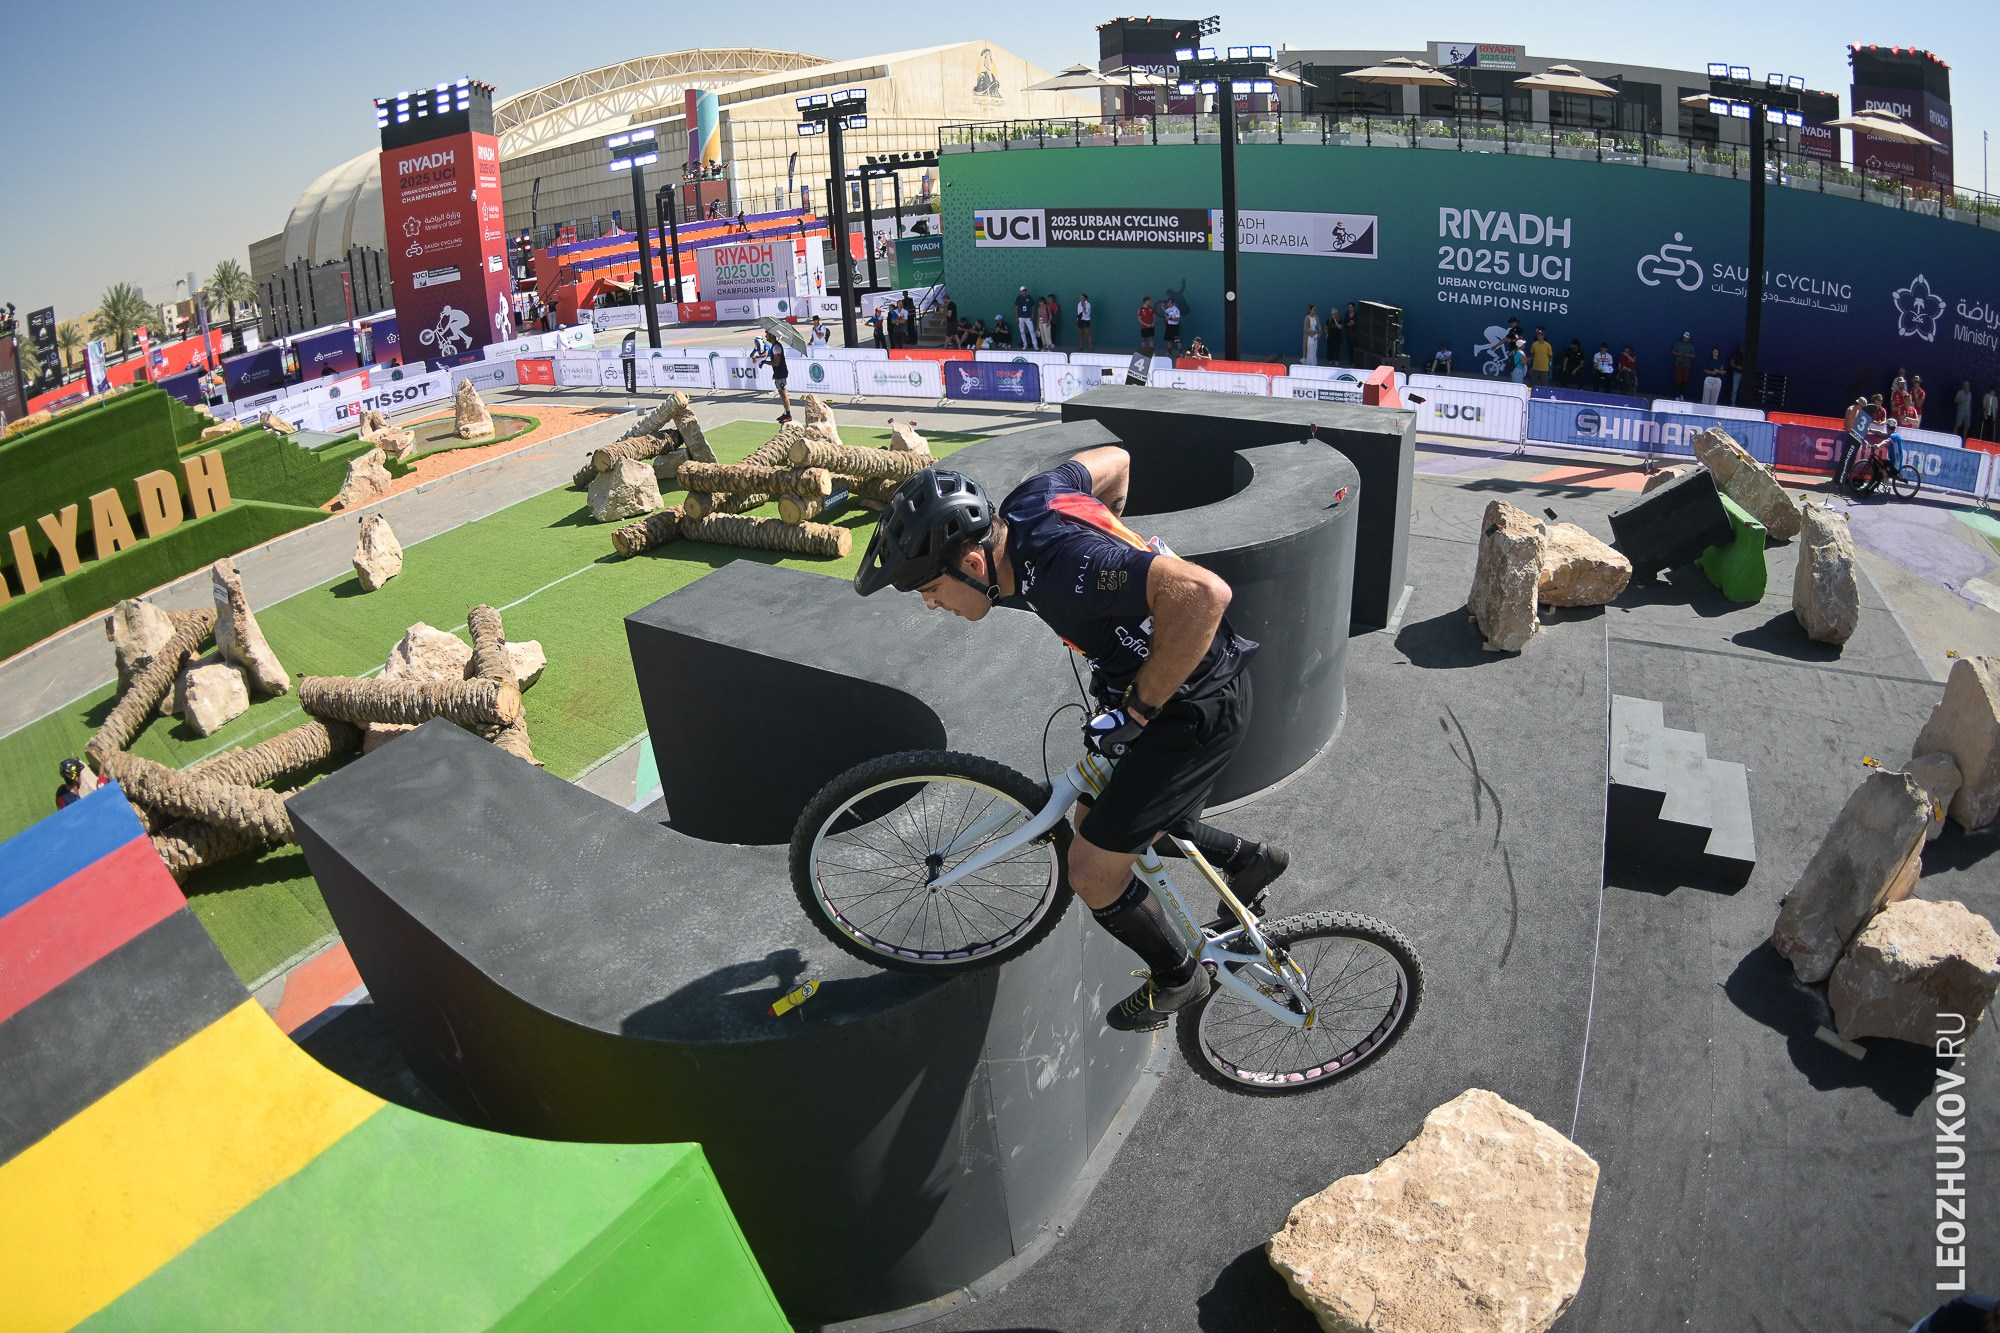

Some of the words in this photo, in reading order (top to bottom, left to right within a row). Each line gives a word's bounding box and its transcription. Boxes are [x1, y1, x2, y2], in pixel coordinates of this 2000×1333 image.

[1480, 44, 1515, 54] RIYADH
[1866, 100, 1912, 118] RIYADH
[1929, 109, 1948, 130] RIYADH
[478, 146, 495, 160] RIYADH
[399, 150, 454, 175] RIYADH
[400, 173, 430, 189] 2025
[433, 168, 456, 181] UCI
[439, 181, 456, 189] WORLD
[402, 187, 457, 203] CHAMPIONSHIPS
[986, 216, 1040, 240] UCI
[1051, 216, 1077, 227] 2025
[1079, 215, 1122, 227] URBAN
[1124, 216, 1179, 228] CYCLING
[1220, 217, 1265, 229] RADH
[1439, 206, 1571, 248] RIYADH
[441, 238, 462, 246] CYCLING
[1051, 229, 1095, 241] WORLD
[1098, 230, 1205, 244] CHAMPIONSHIPS
[1220, 233, 1258, 244] SUDI
[1262, 234, 1309, 247] ARABIA
[714, 244, 773, 266] RIYADH
[912, 242, 940, 251] RIYADH
[715, 264, 747, 280] 2025
[750, 262, 774, 276] UCI
[1438, 246, 1510, 275] 2025
[1518, 252, 1571, 282] UCI
[415, 271, 428, 280] UCI
[1712, 264, 1770, 285] SAUI
[1776, 273, 1852, 299] CYCLING
[717, 285, 776, 295] CHAMPIONSHIPS
[1438, 276, 1476, 288] URBAN
[1478, 280, 1527, 294] CYCLING
[1529, 285, 1570, 298] WORLD
[1437, 290, 1568, 315] CHAMPIONSHIPS
[1954, 324, 1998, 351] Ministry
[625, 342, 632, 353] 5
[1134, 358, 1144, 371] 4
[736, 368, 757, 379] UCI
[363, 382, 430, 410] TISSOT
[1298, 390, 1316, 398] UCI
[1443, 404, 1480, 422] UCI
[1577, 414, 1704, 446] SHIMAN
[1857, 416, 1867, 432] 3
[825, 490, 849, 507] SHIMANO
[1097, 570, 1128, 590] ESP
[1115, 626, 1150, 661] Cofi
